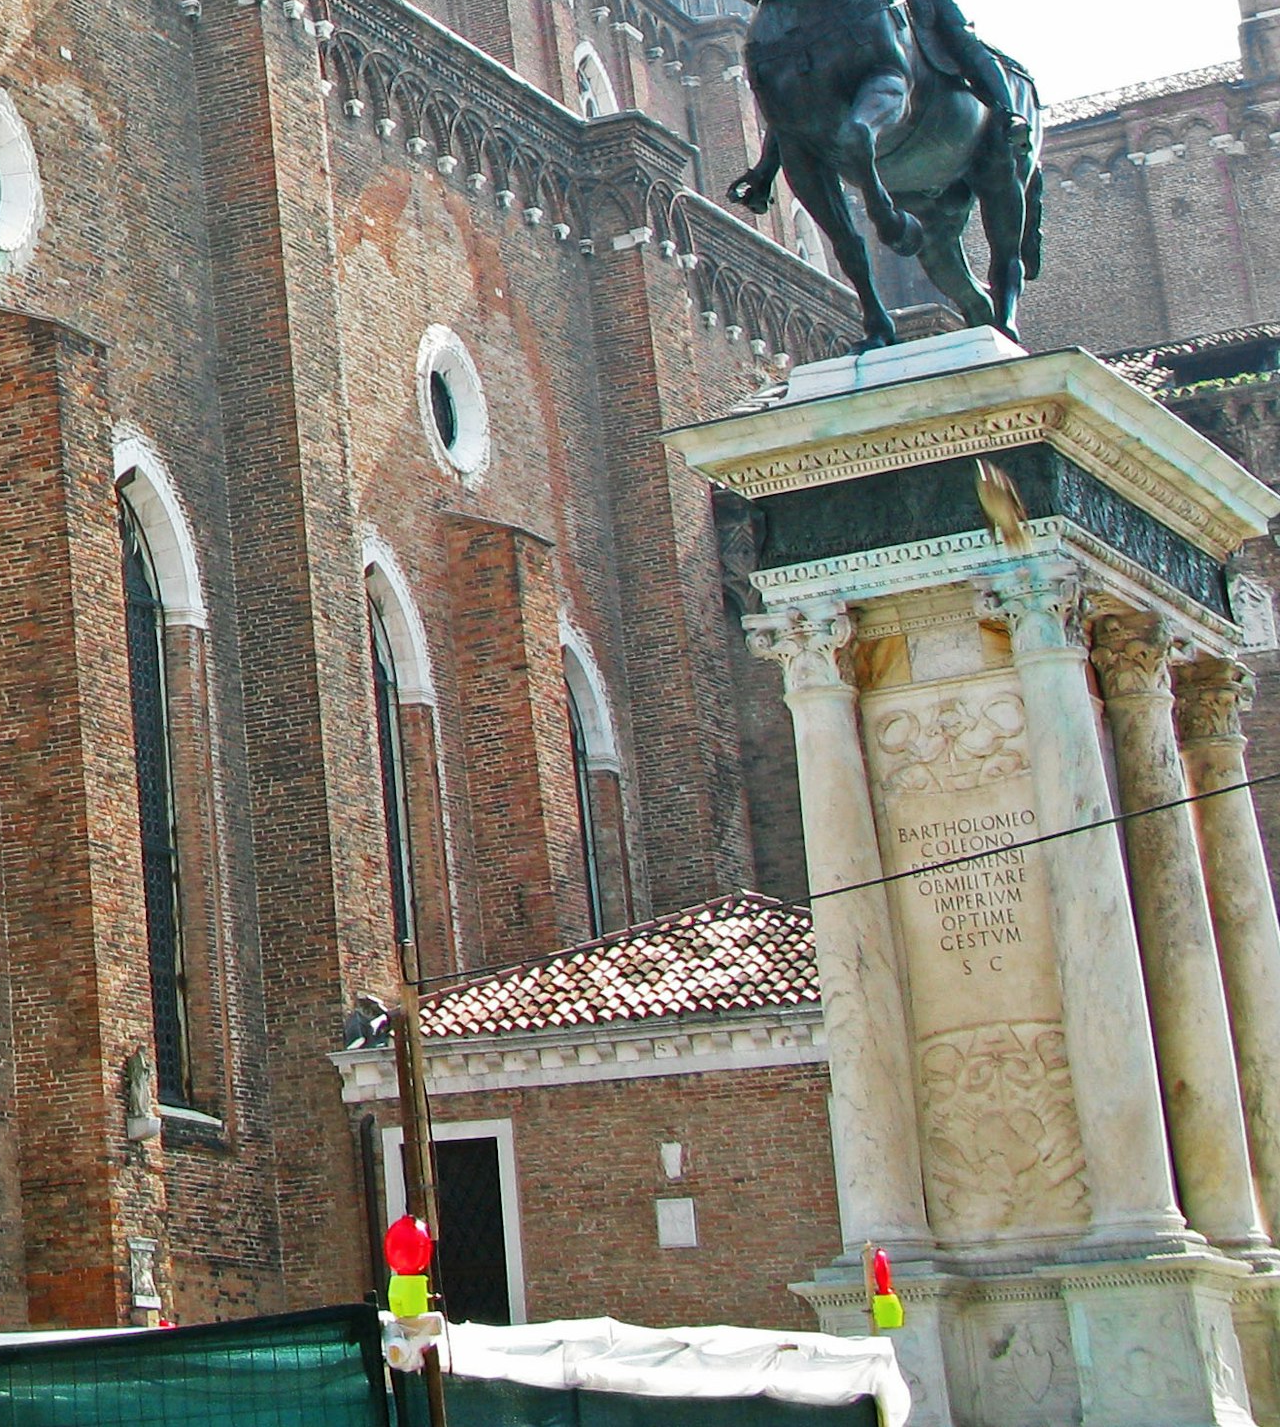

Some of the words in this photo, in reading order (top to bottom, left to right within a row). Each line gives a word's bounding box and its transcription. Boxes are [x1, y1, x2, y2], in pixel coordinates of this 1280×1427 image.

[898, 809, 1035, 843] BARTHOLOMEO
[921, 832, 1014, 858] COLEONO
[935, 888, 1022, 913] IMPERIVM
[942, 908, 1015, 931] OPTIME
[941, 927, 1022, 951] GESTVM
[963, 959, 972, 975] S
[990, 956, 1002, 971] C
